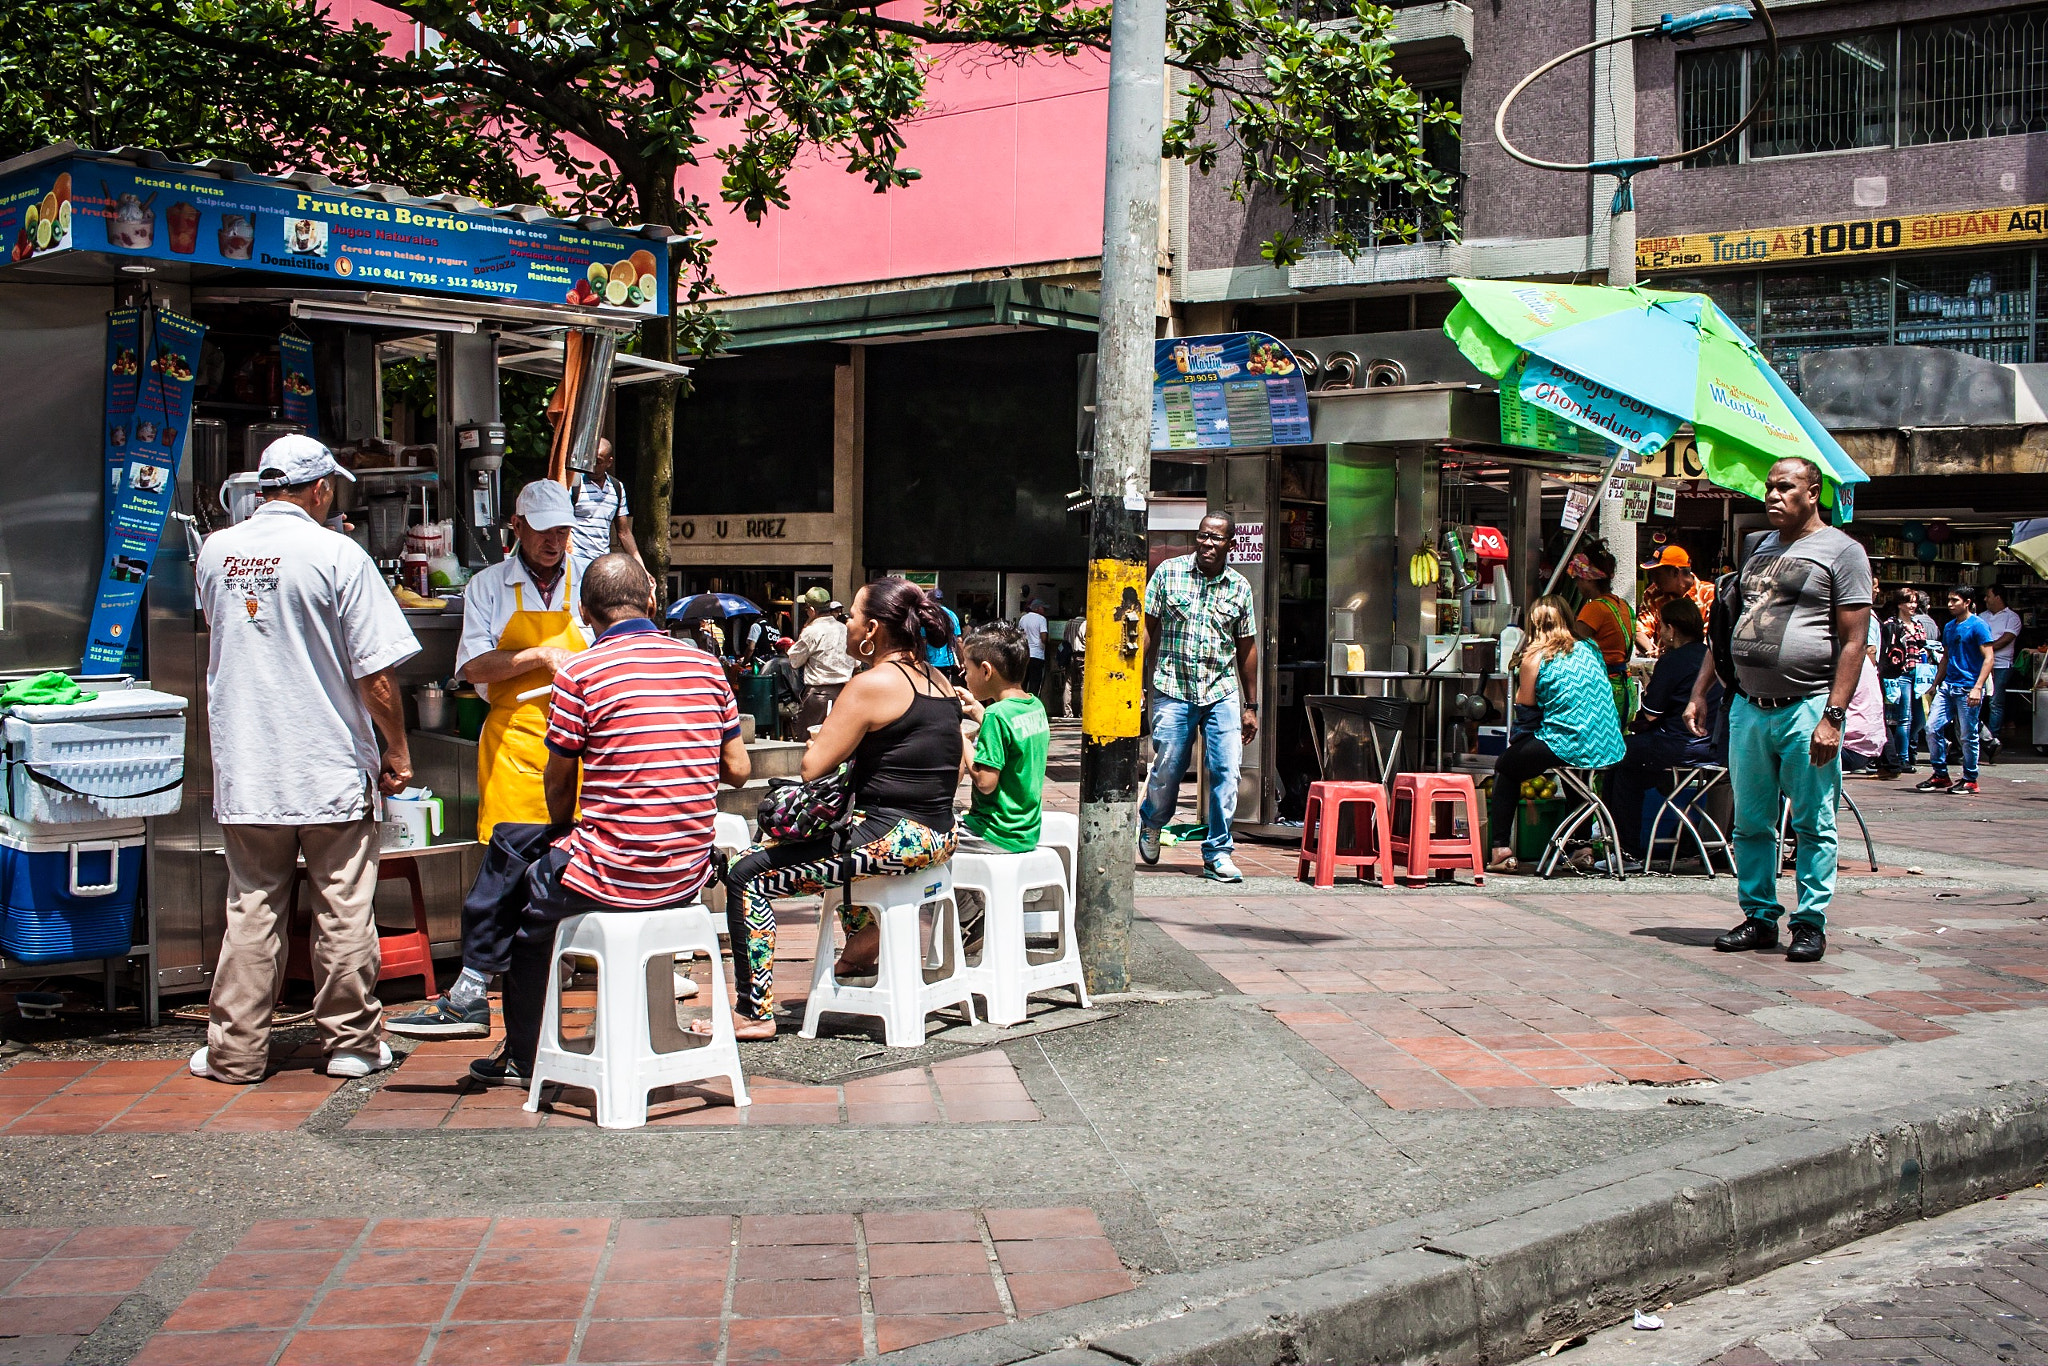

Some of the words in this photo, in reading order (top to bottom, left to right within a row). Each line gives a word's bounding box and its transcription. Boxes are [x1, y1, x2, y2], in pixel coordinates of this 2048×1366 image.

[134, 176, 172, 189] Picada
[174, 182, 187, 191] de
[190, 184, 225, 196] frutas
[71, 194, 117, 206] nsalada
[239, 203, 256, 211] con
[258, 205, 290, 216] helado
[296, 194, 390, 222] Frutera
[394, 207, 469, 232] Berrío
[331, 224, 371, 239] Jugos
[375, 229, 439, 247] Naturales
[469, 221, 514, 235] Limonada
[516, 228, 527, 237] de
[528, 231, 548, 239] coco
[580, 237, 591, 246] de
[592, 240, 625, 250] naranja
[1708, 234, 1767, 262] Todo
[1773, 234, 1788, 251] A
[1912, 214, 2000, 241] SUBAN
[530, 241, 541, 249] de
[543, 244, 590, 255] mandarina
[341, 244, 372, 255] Cereal
[374, 249, 391, 258] con
[394, 251, 426, 262] helado
[428, 256, 434, 264] y
[436, 257, 468, 267] yogurt
[510, 249, 553, 261] Porciones
[260, 253, 330, 272] Domicilios
[530, 262, 569, 274] Sorbetes
[358, 266, 381, 277] 310
[383, 268, 406, 280] 841
[409, 271, 437, 285] 7935
[447, 277, 468, 287] 312
[470, 279, 518, 294] 2633757
[527, 272, 572, 284] Malteadas
[1184, 375, 1195, 383] 231
[1196, 374, 1207, 382] 90
[1207, 373, 1217, 381] 53
[1535, 382, 1642, 443] Chontaduro
[1619, 395, 1654, 419] con
[132, 496, 158, 506] Jugos
[1839, 489, 1853, 506] OS
[122, 503, 164, 516] naturales
[1625, 499, 1648, 510] FRUTAS
[1235, 525, 1263, 535] NSALADA
[1234, 543, 1263, 552] RUTAS
[223, 556, 281, 567] Frutera
[1229, 553, 1234, 562] $
[1239, 553, 1261, 562] 3.500
